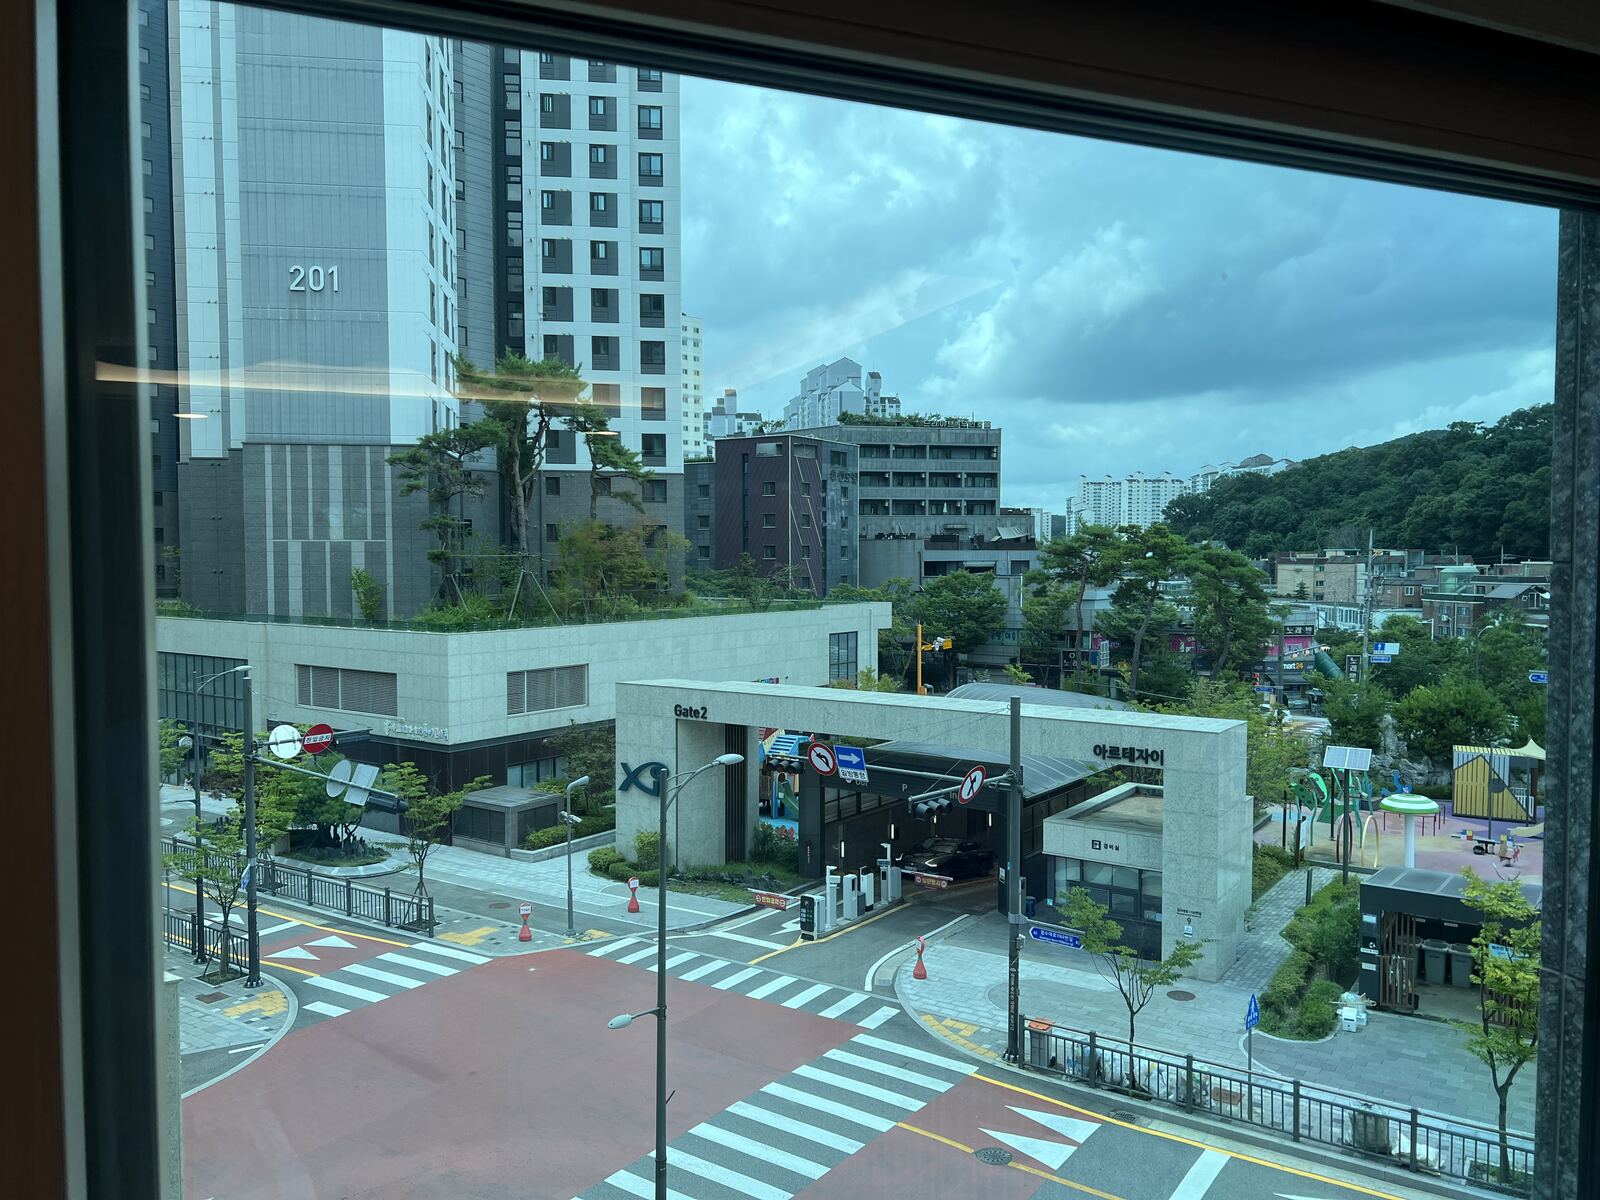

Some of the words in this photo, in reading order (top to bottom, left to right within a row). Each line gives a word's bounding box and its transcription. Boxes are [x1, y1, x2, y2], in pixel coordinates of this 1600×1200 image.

[289, 264, 339, 292] 201
[306, 734, 331, 744] 진입금지
[1093, 744, 1164, 766] 아르테자이
[840, 768, 866, 780] 일방통행
